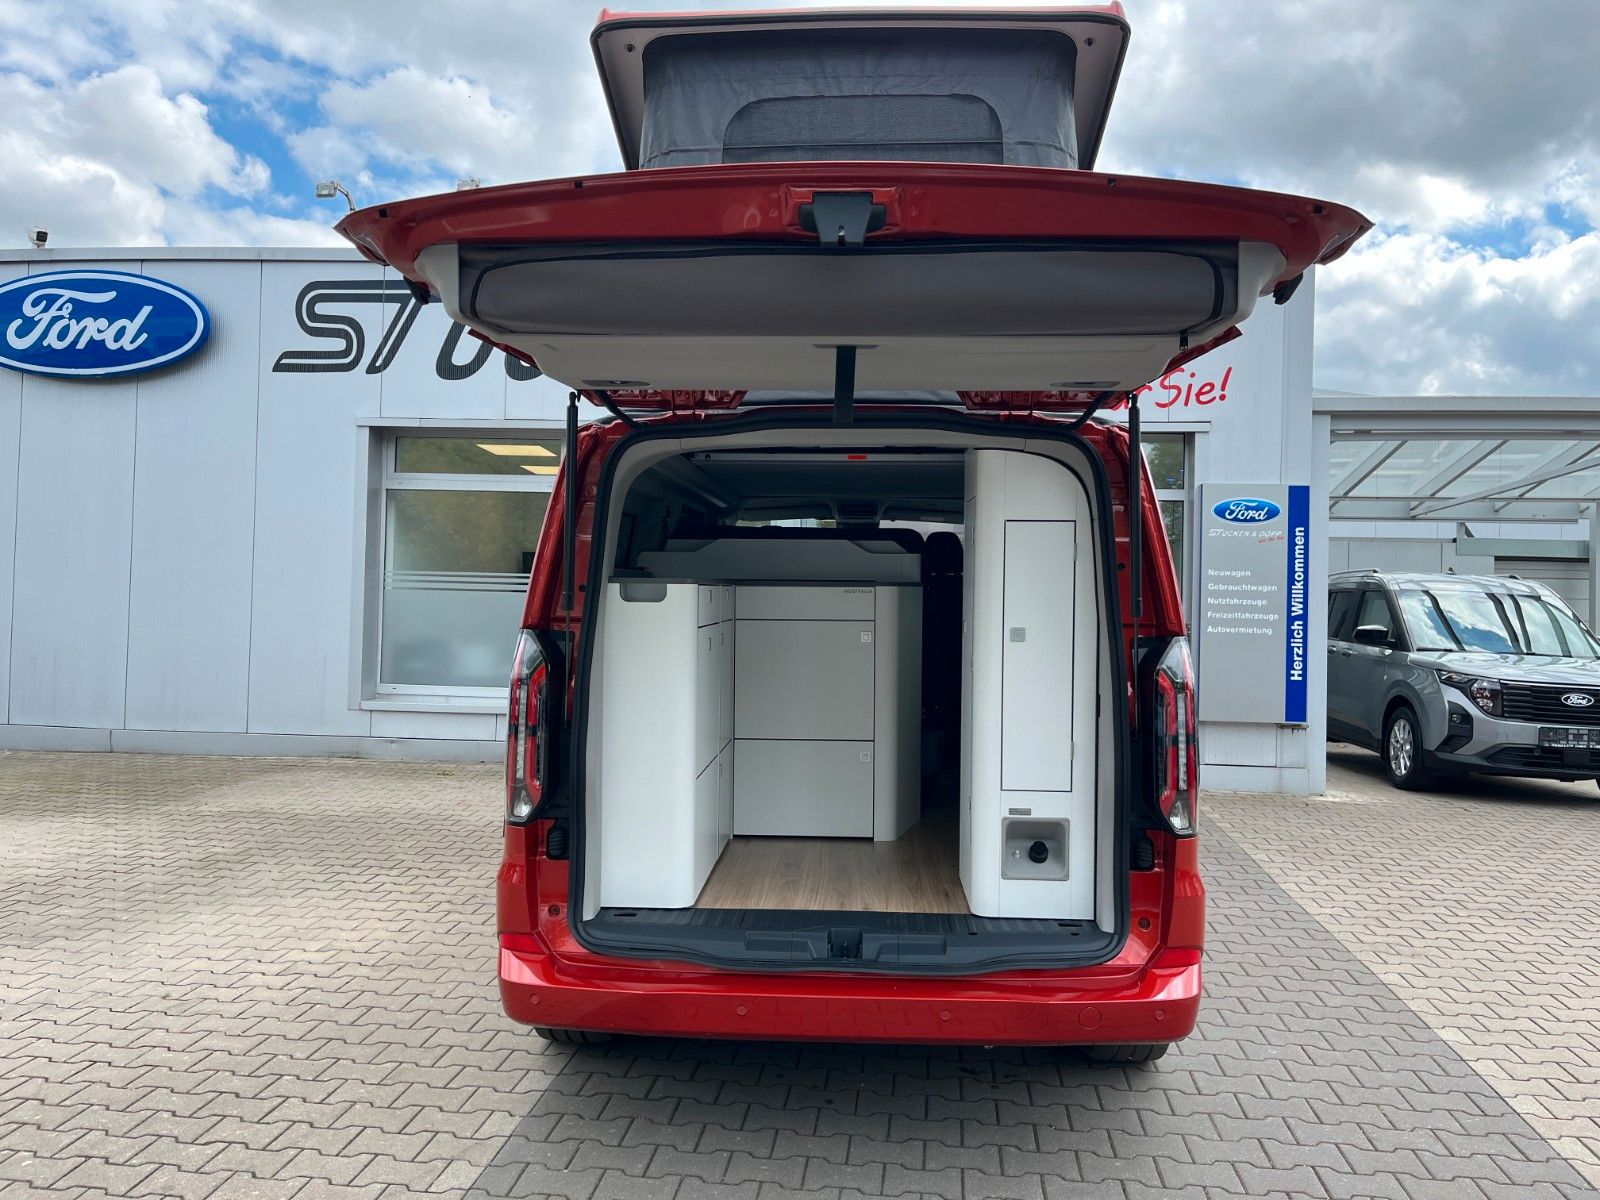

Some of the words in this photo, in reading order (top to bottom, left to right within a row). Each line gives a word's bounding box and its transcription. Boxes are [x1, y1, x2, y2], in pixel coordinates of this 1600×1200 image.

[6, 287, 154, 351] Ford
[1155, 366, 1233, 409] Sie!
[1224, 500, 1269, 520] Ford
[1208, 528, 1250, 537] STUCKEN
[1208, 569, 1251, 577] Neuwagen
[1291, 527, 1305, 617] Willkommen
[1207, 583, 1278, 592] Gebrauchtwagen
[1207, 597, 1267, 606] Nutzfahrzeuge
[1207, 611, 1279, 621] Freizeitfahrzeuge
[1207, 625, 1272, 635] Autovermietung
[1290, 620, 1303, 681] Herzlich
[1567, 695, 1588, 704] Ford
